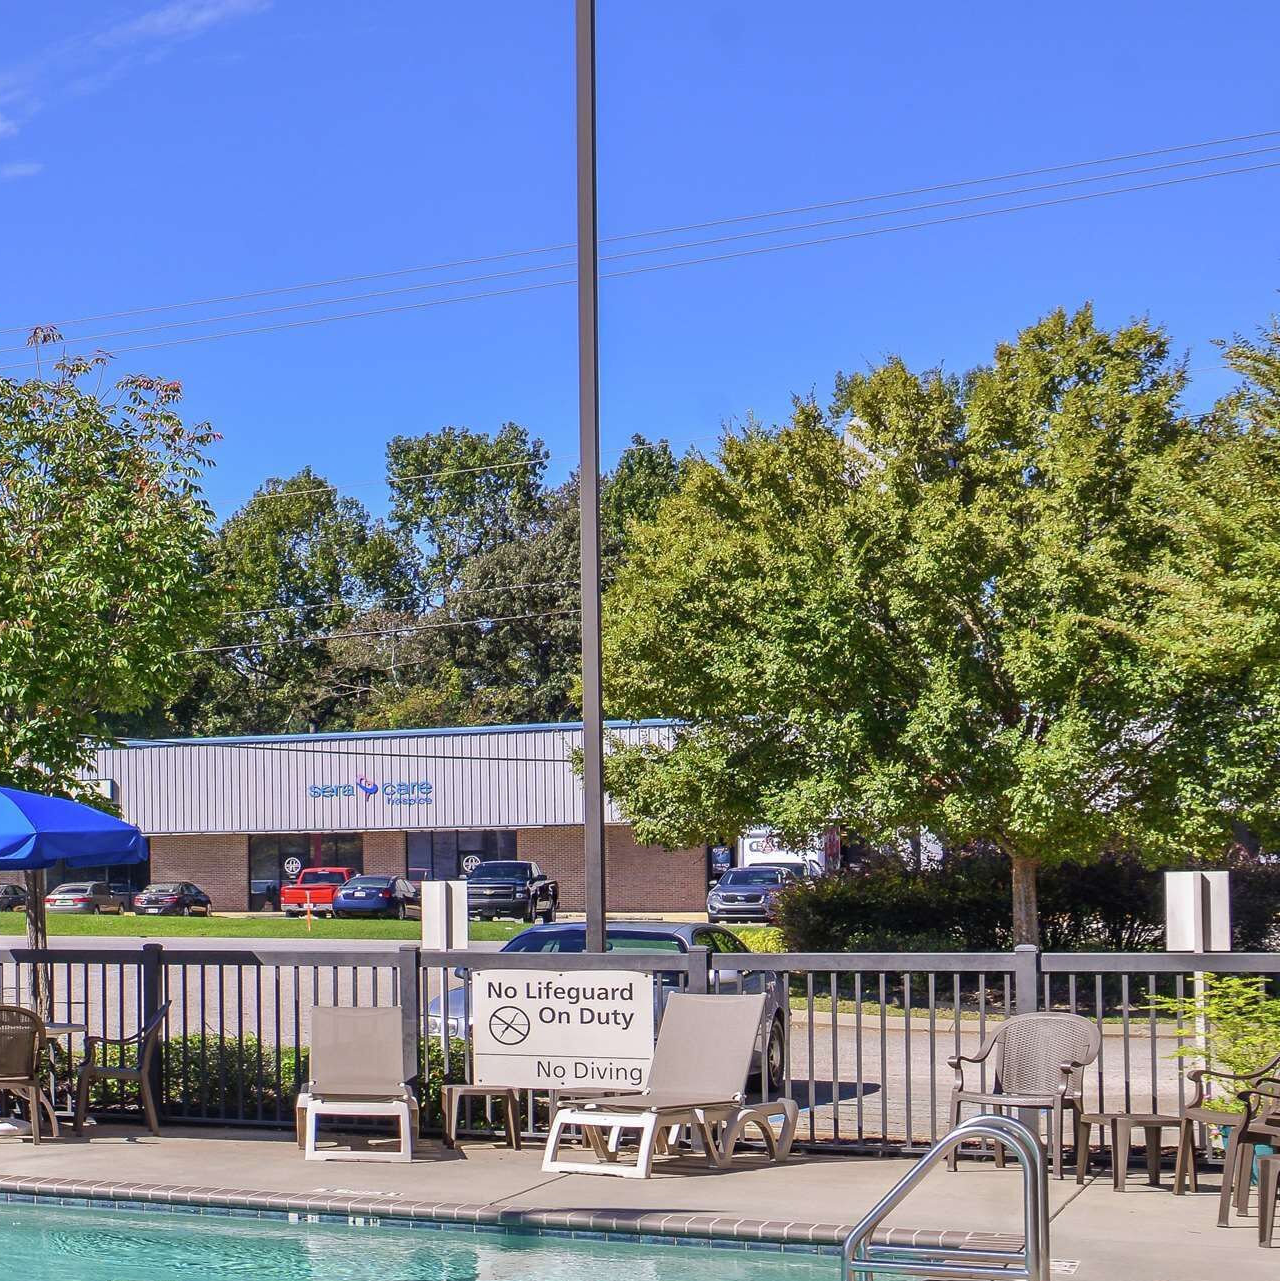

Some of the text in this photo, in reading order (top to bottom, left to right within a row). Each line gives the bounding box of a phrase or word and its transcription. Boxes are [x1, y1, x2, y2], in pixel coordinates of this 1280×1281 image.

[309, 781, 433, 798] sera care
[487, 981, 633, 1005] No Lifeguard
[538, 1006, 634, 1031] On Duty
[537, 1061, 642, 1086] No Diving
